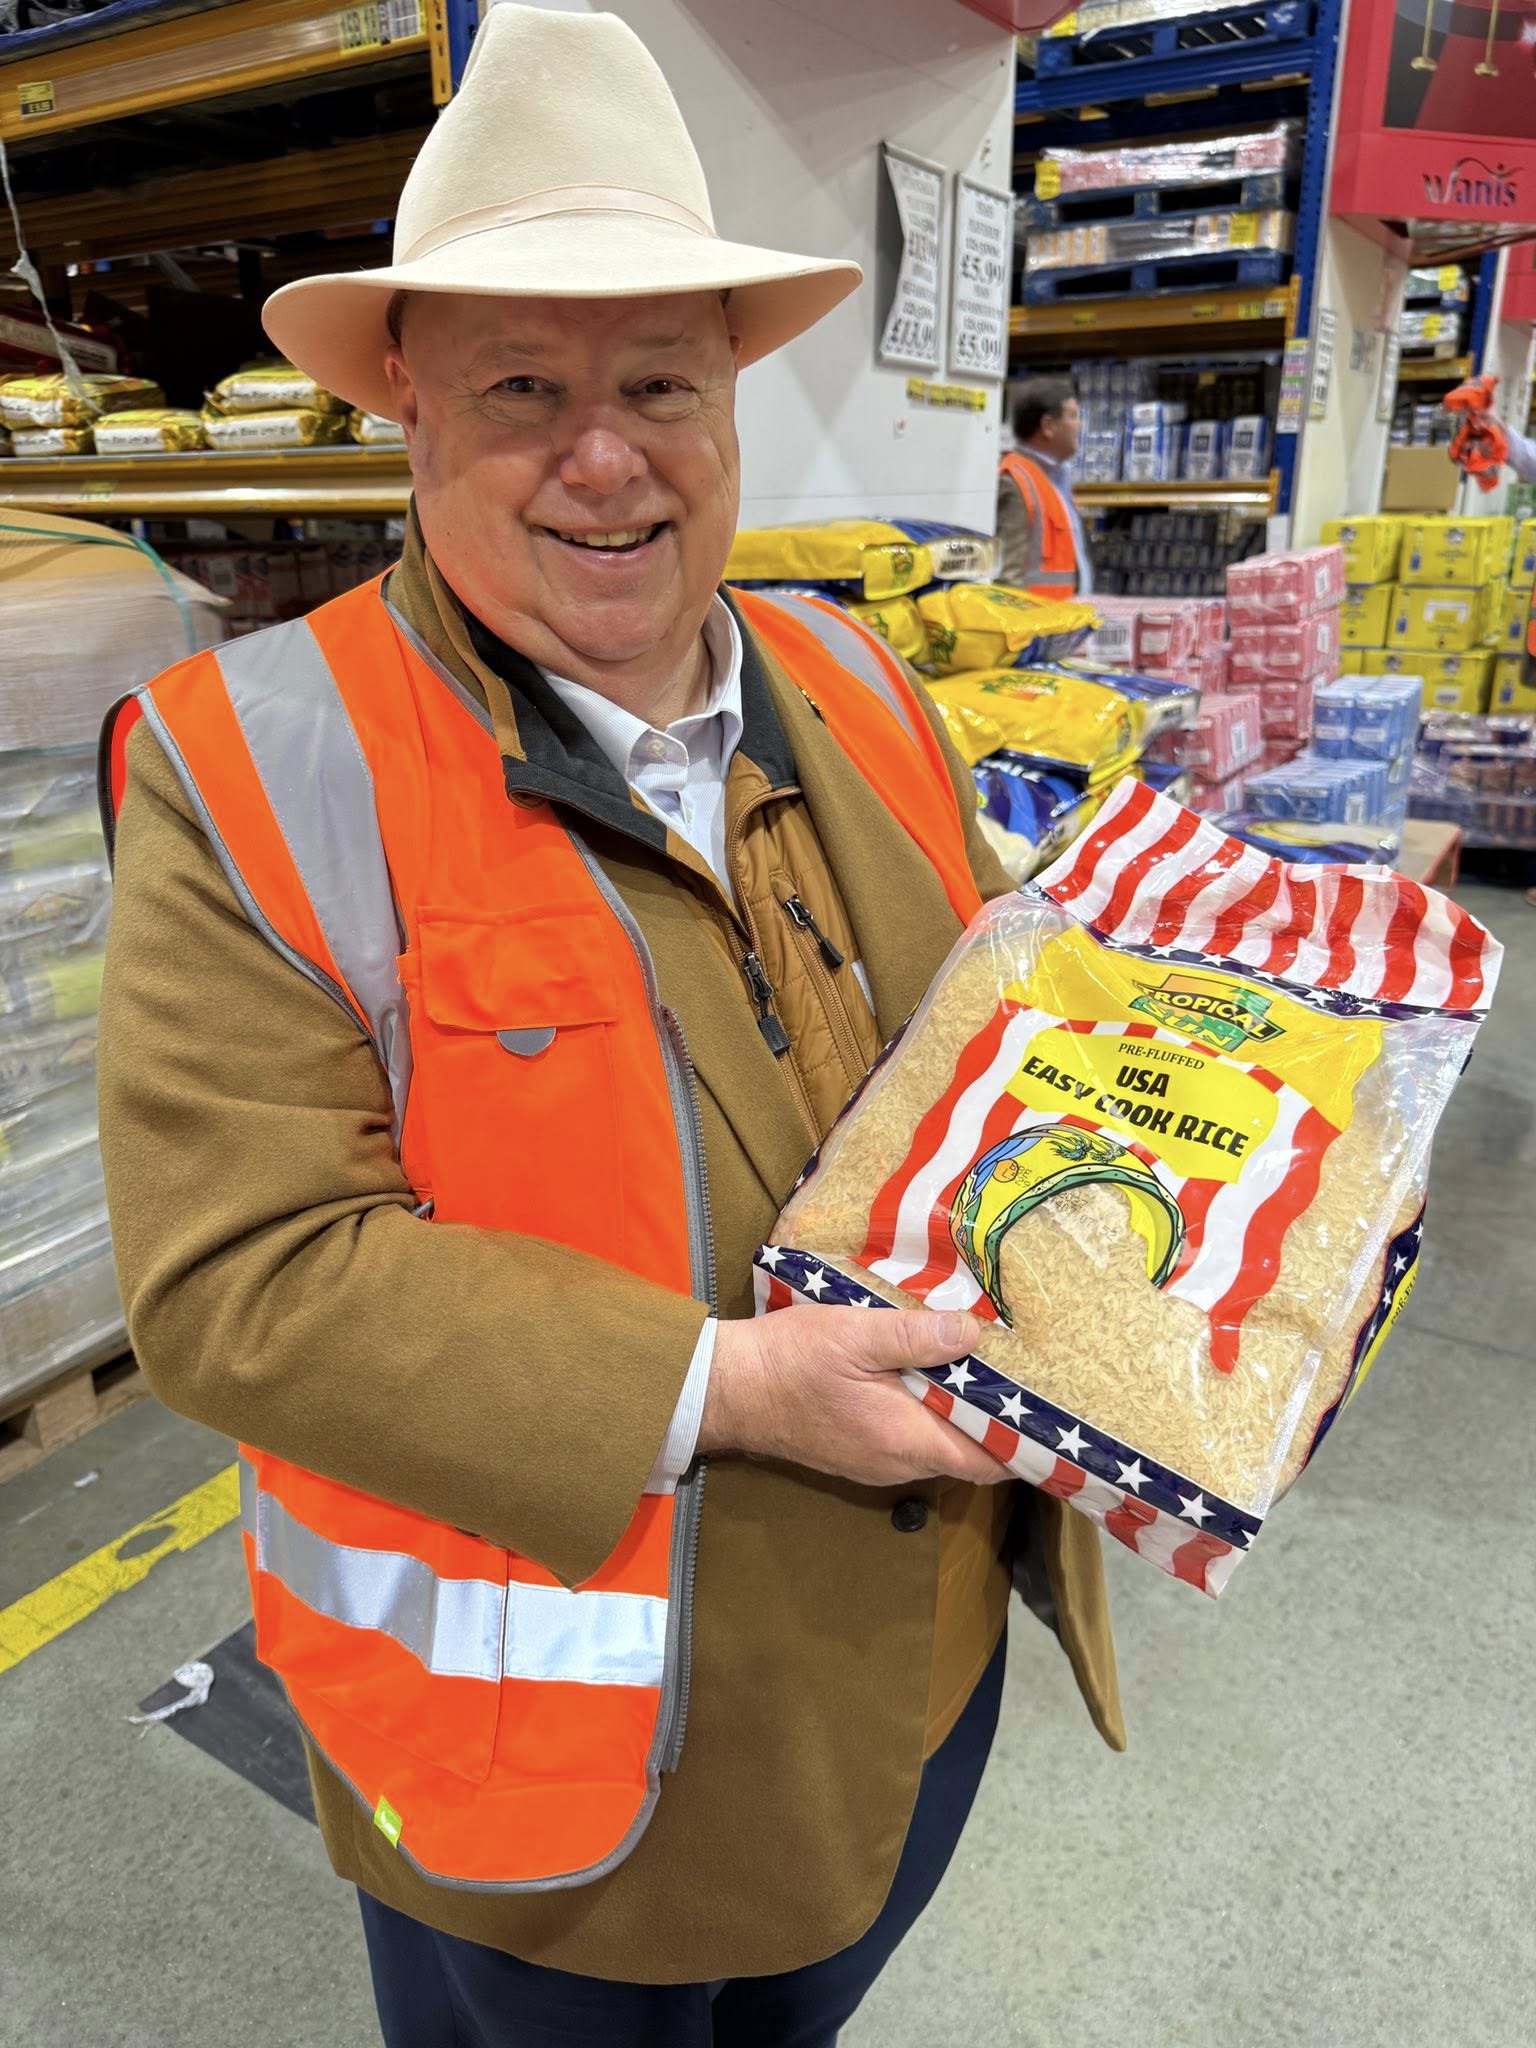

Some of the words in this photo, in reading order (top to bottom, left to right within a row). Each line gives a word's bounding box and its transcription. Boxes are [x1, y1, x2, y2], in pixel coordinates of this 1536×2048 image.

[1422, 157, 1523, 208] Wanis
[958, 333, 1002, 361] £5.99
[1132, 980, 1267, 1038] TROPICAL
[1142, 1002, 1233, 1047] SUN
[1118, 1043, 1205, 1070] PRE-FLUFFED
[1116, 1066, 1170, 1097] USA
[1022, 1056, 1096, 1100] EASY
[1094, 1094, 1173, 1134] COOK
[1174, 1115, 1249, 1158] RICE
